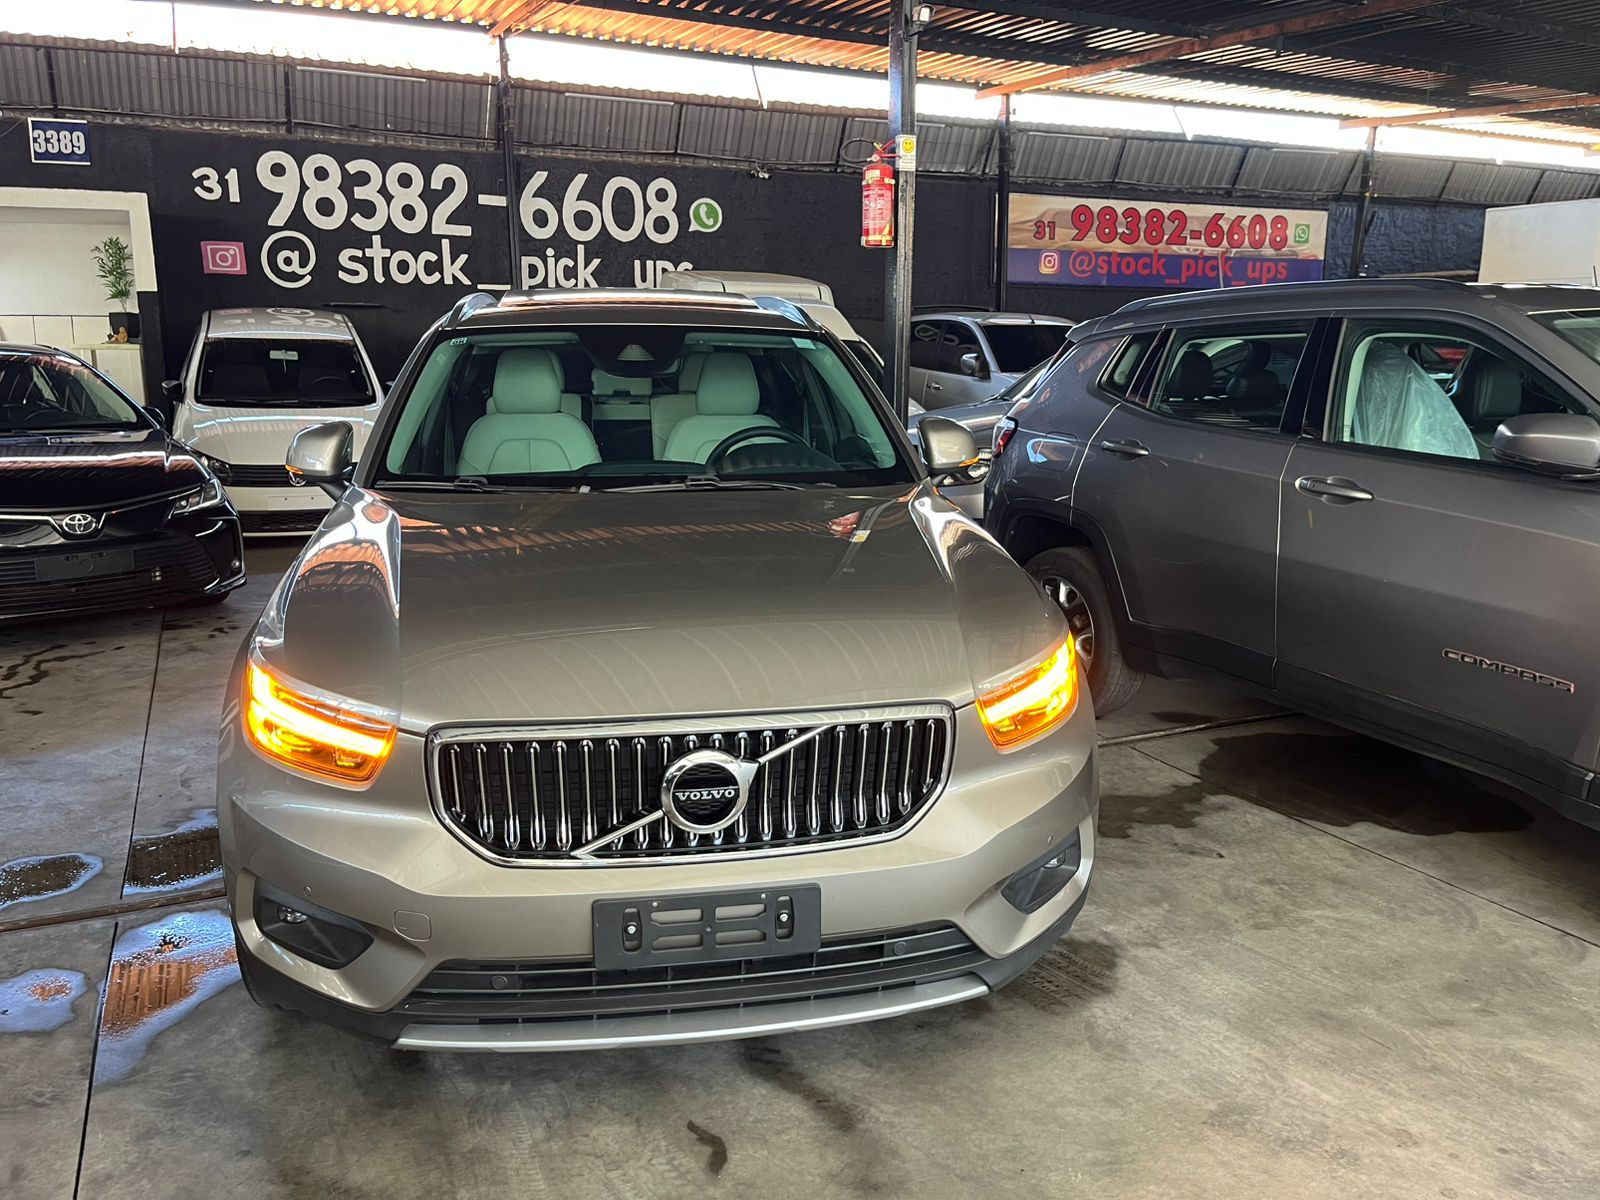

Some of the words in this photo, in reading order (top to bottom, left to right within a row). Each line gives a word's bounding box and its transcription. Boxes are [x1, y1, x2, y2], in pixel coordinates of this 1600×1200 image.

[32, 129, 86, 154] 3389
[192, 167, 241, 202] 31
[256, 150, 679, 243] 98382-6608
[1033, 219, 1056, 240] 31
[1071, 204, 1288, 250] 98382-6608
[1442, 648, 1574, 694] COMPASS
[675, 788, 735, 801] VOLVO
